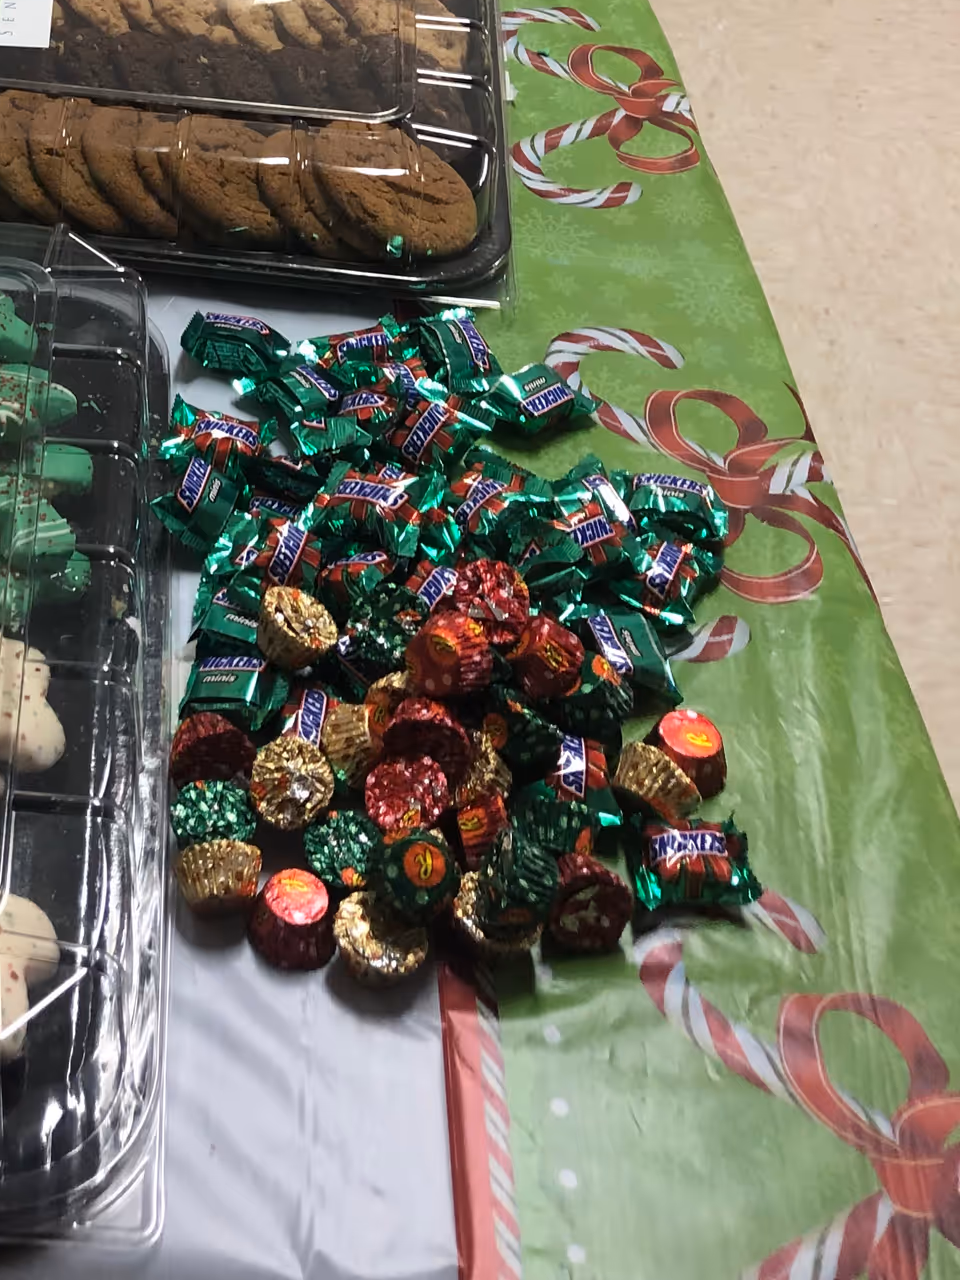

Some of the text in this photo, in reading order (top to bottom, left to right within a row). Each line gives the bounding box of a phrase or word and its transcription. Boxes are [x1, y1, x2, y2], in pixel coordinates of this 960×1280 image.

[522, 376, 547, 392] minis
[524, 383, 570, 414] NICKER
[195, 420, 259, 449] SNICKERS
[404, 404, 448, 459] NICKERS
[208, 477, 222, 503] minis
[224, 612, 260, 629] minis
[202, 673, 237, 684] minis
